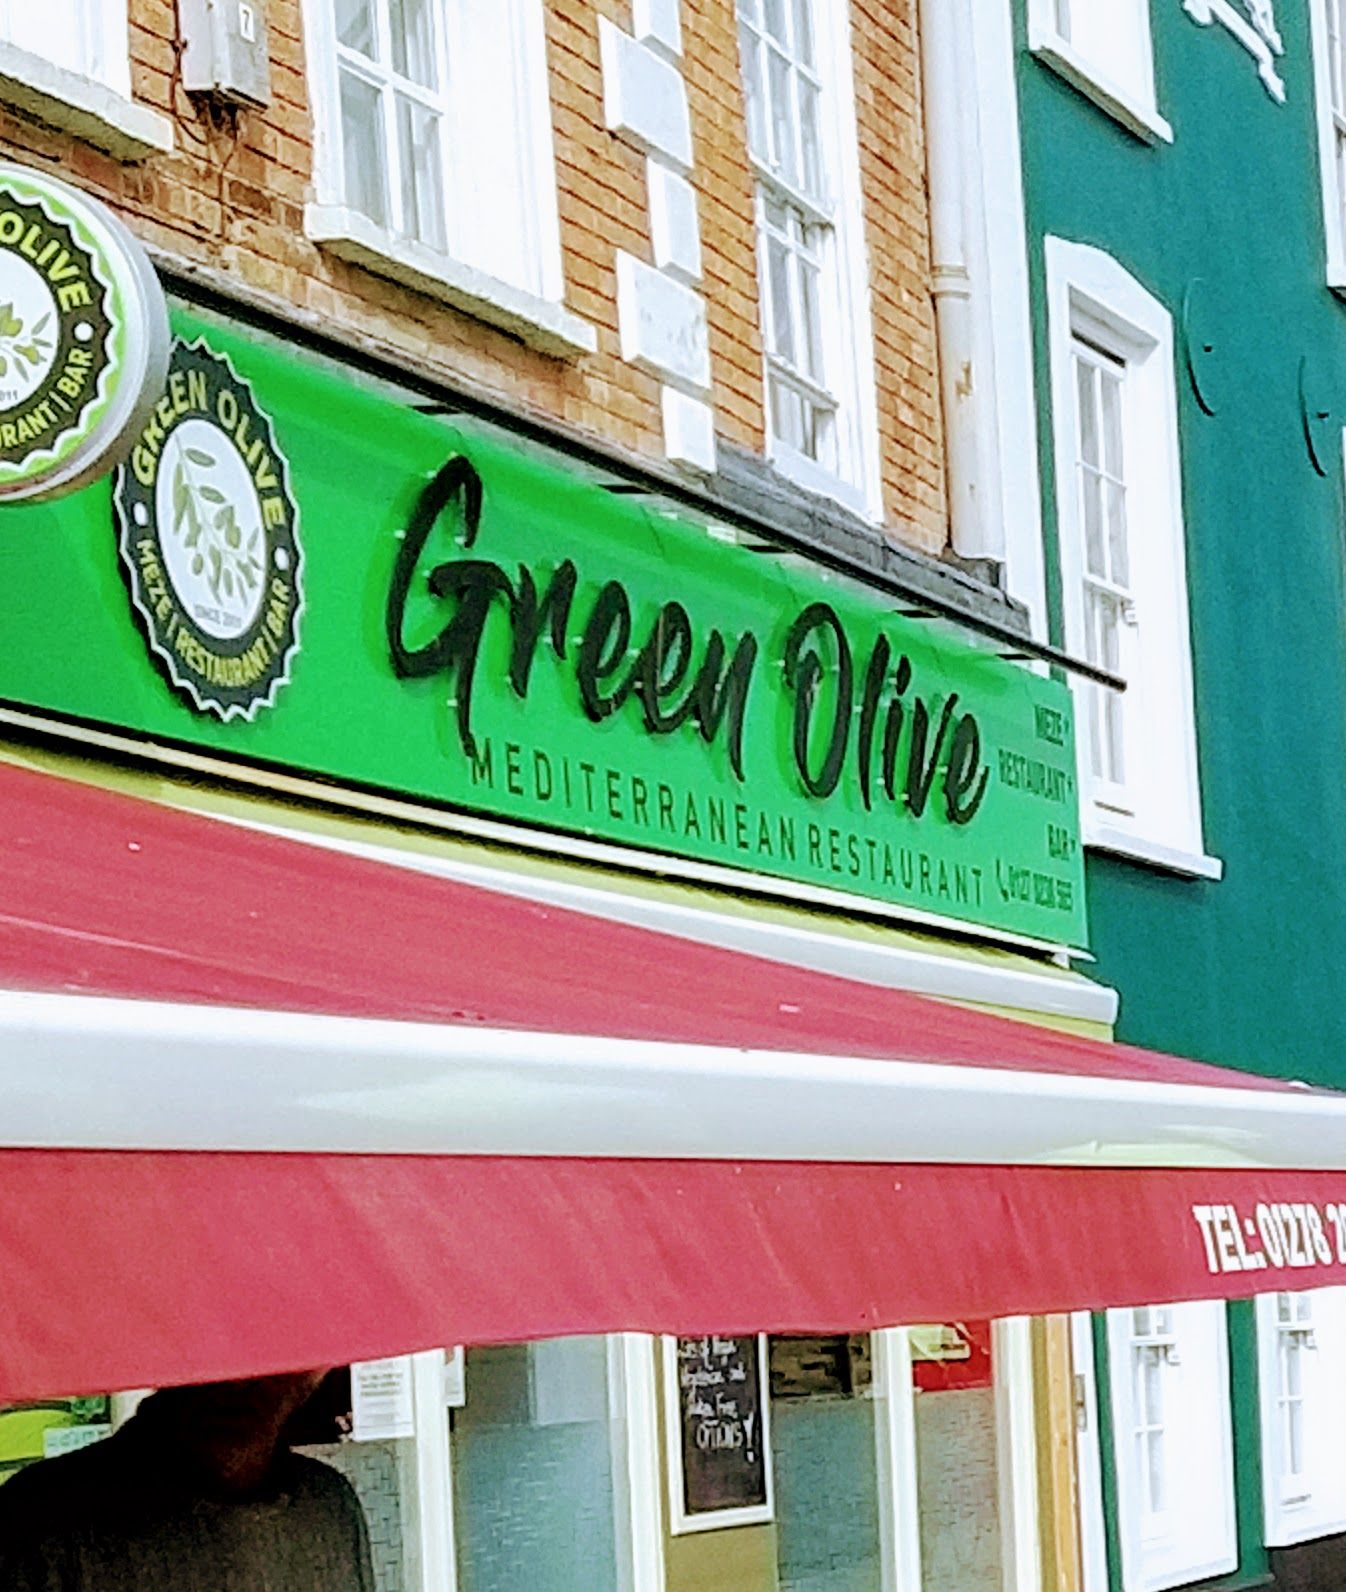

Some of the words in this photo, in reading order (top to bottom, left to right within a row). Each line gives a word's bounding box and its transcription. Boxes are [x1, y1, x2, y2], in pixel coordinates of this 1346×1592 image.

[0, 211, 94, 313] OLIVE
[57, 348, 93, 398] BAR
[217, 389, 286, 531] OLIVE
[136, 539, 173, 621] MEZE
[175, 627, 272, 687] RESTAURANT
[266, 578, 291, 638] BAR
[386, 455, 758, 782] Green
[784, 602, 990, 825] Olive
[998, 748, 1067, 804] RESTAURANT
[1034, 704, 1064, 746] MEZE
[471, 739, 796, 861] MEDITERRANEAN
[807, 822, 984, 908] RESTAURANT
